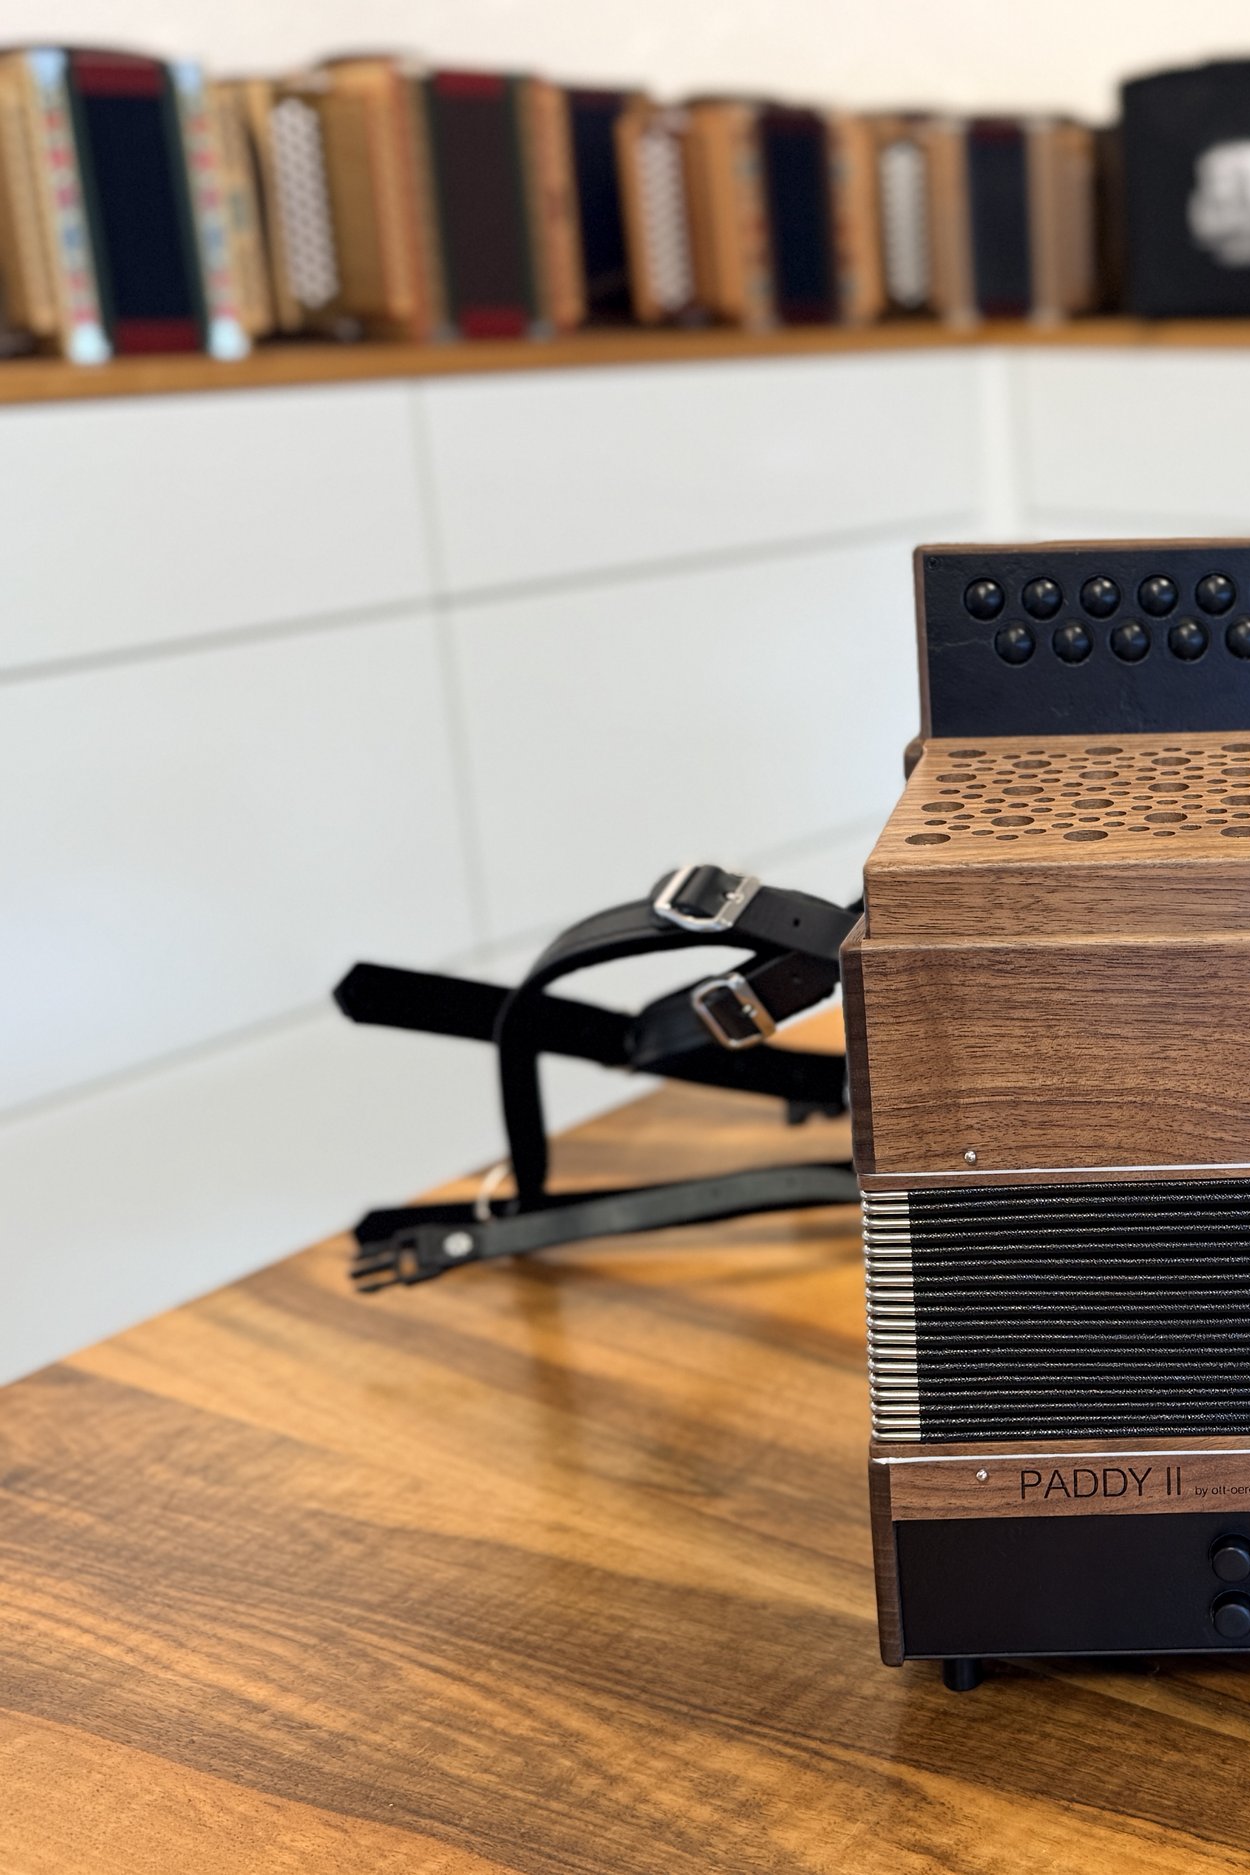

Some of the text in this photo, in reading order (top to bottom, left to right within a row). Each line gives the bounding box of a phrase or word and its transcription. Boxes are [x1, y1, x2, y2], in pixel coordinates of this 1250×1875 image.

[1020, 1467, 1153, 1500] PADDY
[1166, 1466, 1182, 1496] II
[1194, 1485, 1209, 1498] by
